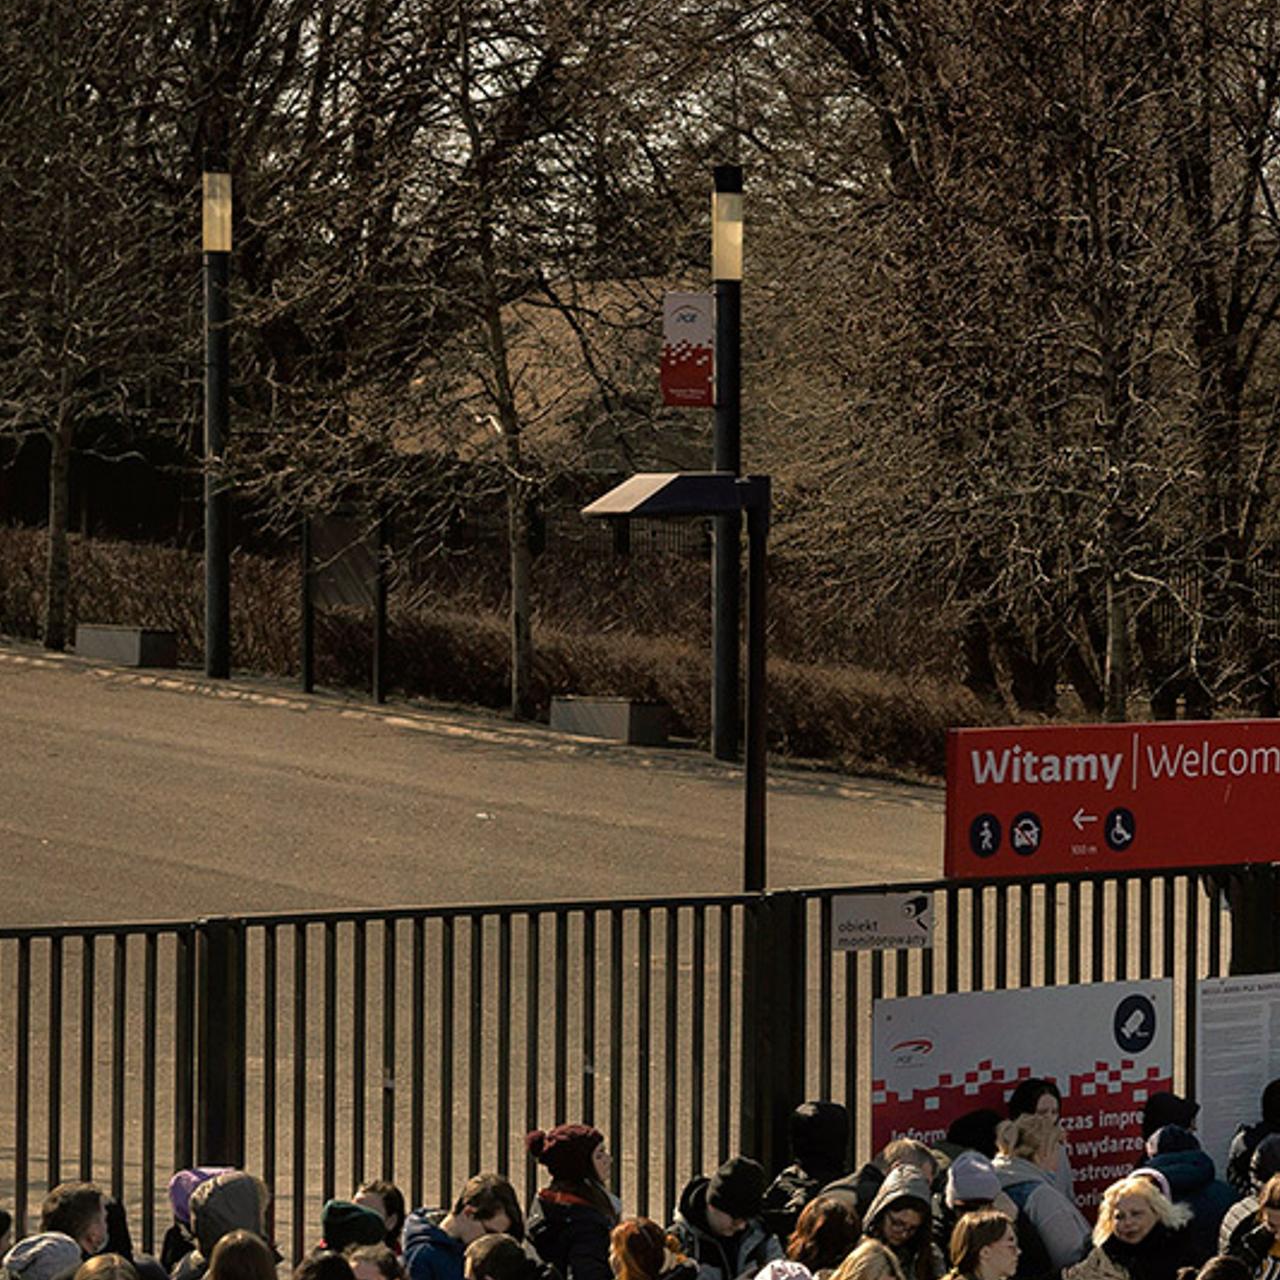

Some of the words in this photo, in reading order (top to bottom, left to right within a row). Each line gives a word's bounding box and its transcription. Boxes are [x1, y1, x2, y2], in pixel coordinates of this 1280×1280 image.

[970, 744, 1122, 791] Witamy
[838, 920, 878, 933] obiekt
[1060, 1115, 1094, 1130] czas
[1099, 1109, 1145, 1130] impre
[891, 1128, 947, 1144] Inform
[1076, 1134, 1144, 1158] wydarze
